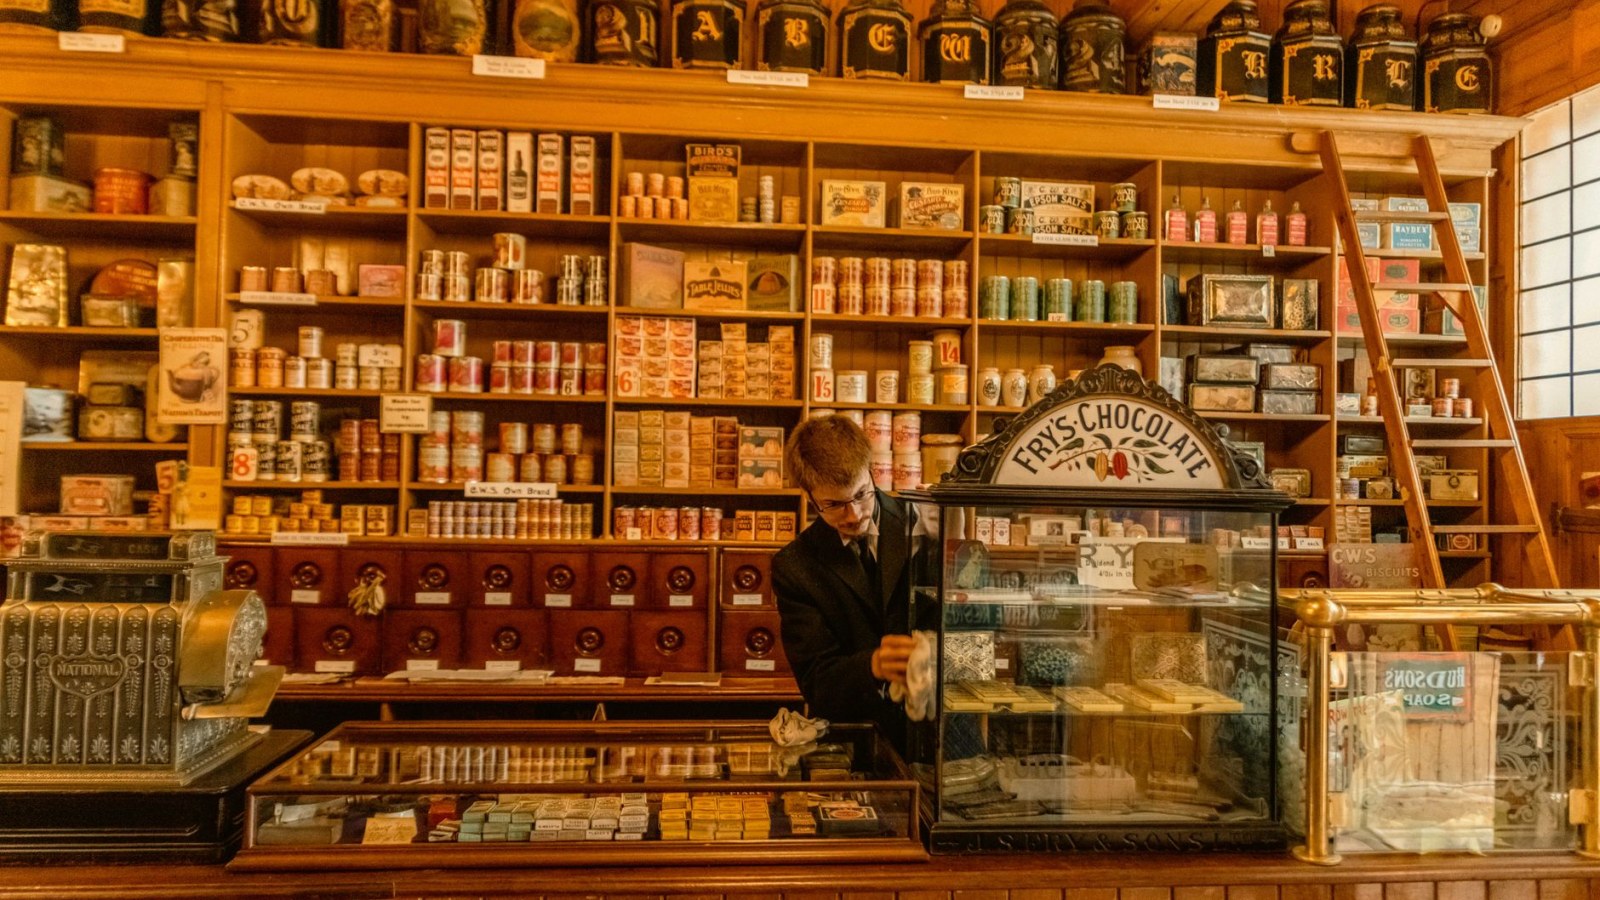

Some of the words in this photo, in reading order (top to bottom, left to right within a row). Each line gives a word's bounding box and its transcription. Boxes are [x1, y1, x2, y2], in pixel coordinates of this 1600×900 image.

[692, 10, 723, 41] A
[784, 18, 809, 48] B
[694, 146, 734, 156] BIRD'S
[299, 204, 322, 212] Brand
[1029, 195, 1058, 208] EPSOM
[1060, 195, 1087, 209] SALTS
[690, 281, 711, 297] TABLE
[710, 279, 741, 298] JELLIES
[1012, 415, 1077, 475] FRY'S
[1077, 402, 1213, 480] CHOCOLATE
[503, 487, 522, 495] Own
[527, 487, 551, 496] Brand
[128, 544, 159, 554] CASH
[1332, 548, 1378, 564] CWS
[1366, 567, 1419, 578] BISCUITS
[57, 662, 118, 678] NATIONAL
[1093, 832, 1111, 853] &
[1122, 832, 1205, 854] SONS
